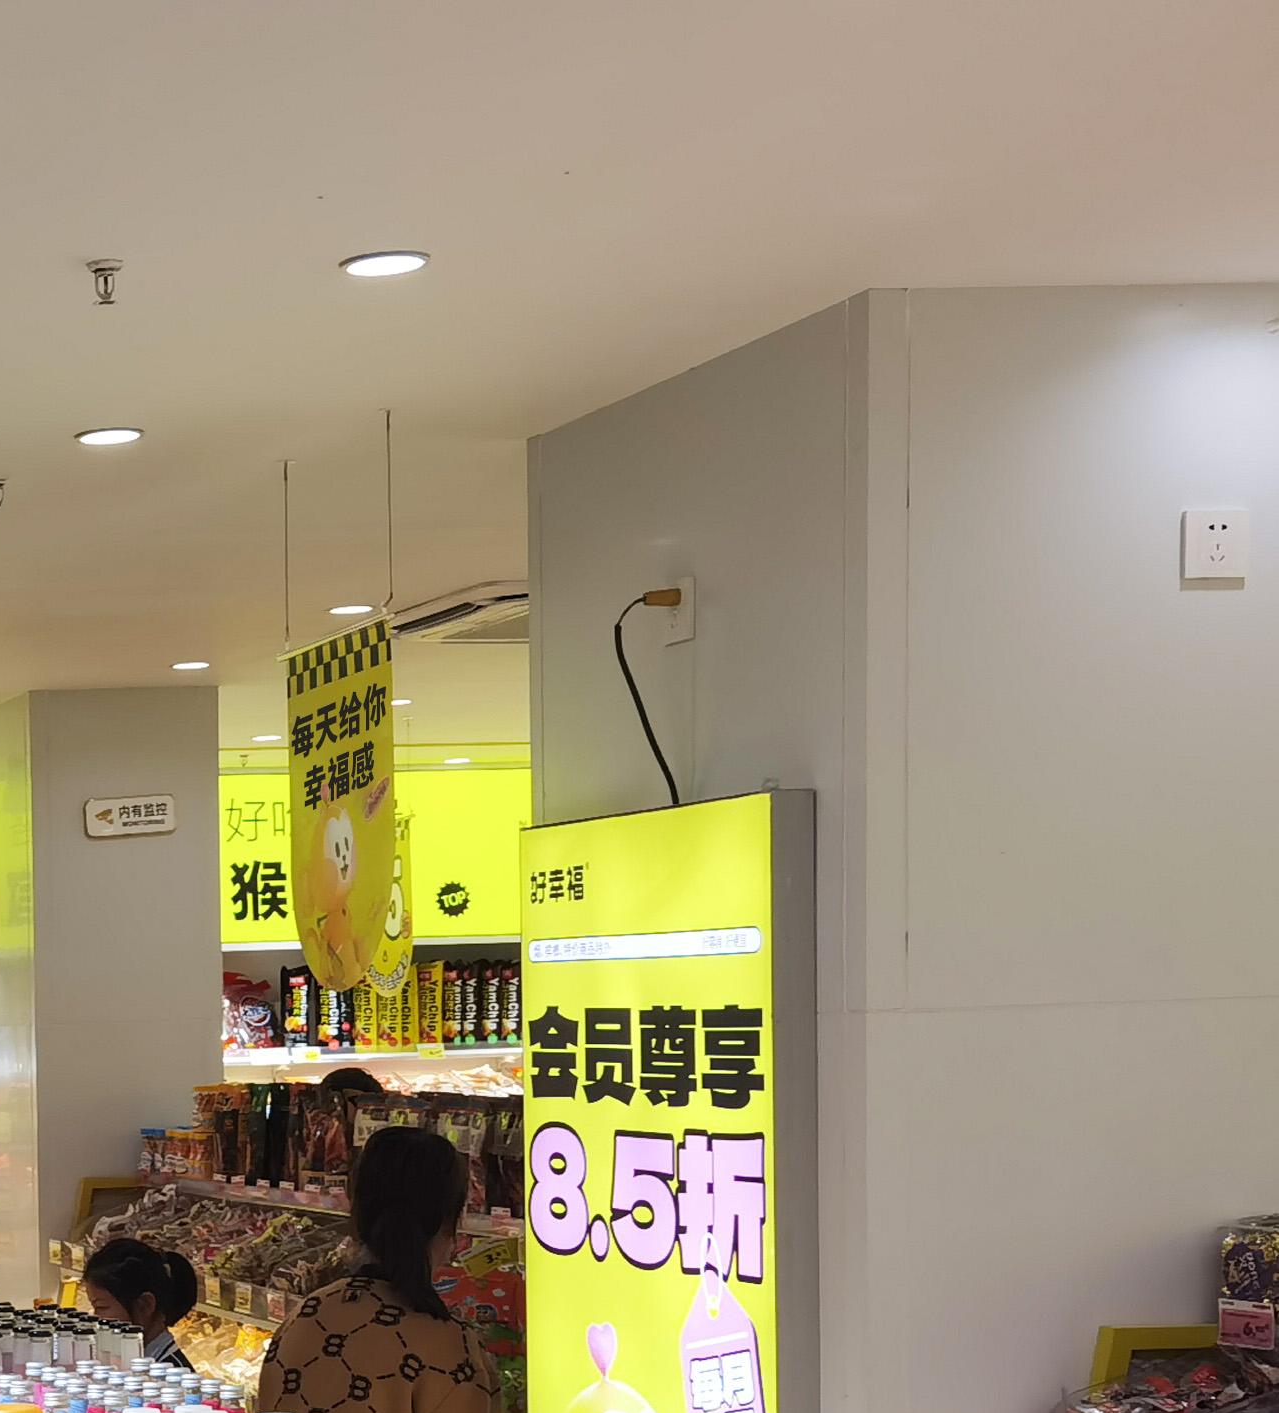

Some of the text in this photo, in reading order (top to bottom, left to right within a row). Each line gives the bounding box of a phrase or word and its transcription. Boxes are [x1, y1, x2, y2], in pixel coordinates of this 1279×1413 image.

[292, 683, 387, 758] 每天给你
[303, 741, 375, 810] 幸福感
[118, 803, 168, 819] 内有监控
[231, 861, 289, 921] 猴
[441, 891, 467, 908] TOP
[529, 865, 584, 904] 好幸福
[427, 979, 439, 1033] YamChip
[466, 977, 478, 1032] YamChip
[488, 977, 500, 1032] YamChip
[507, 976, 520, 1031] YamChip
[529, 1005, 766, 1107] 会员尊享
[529, 1121, 766, 1284] 8.5折
[690, 1350, 754, 1411] 每月
